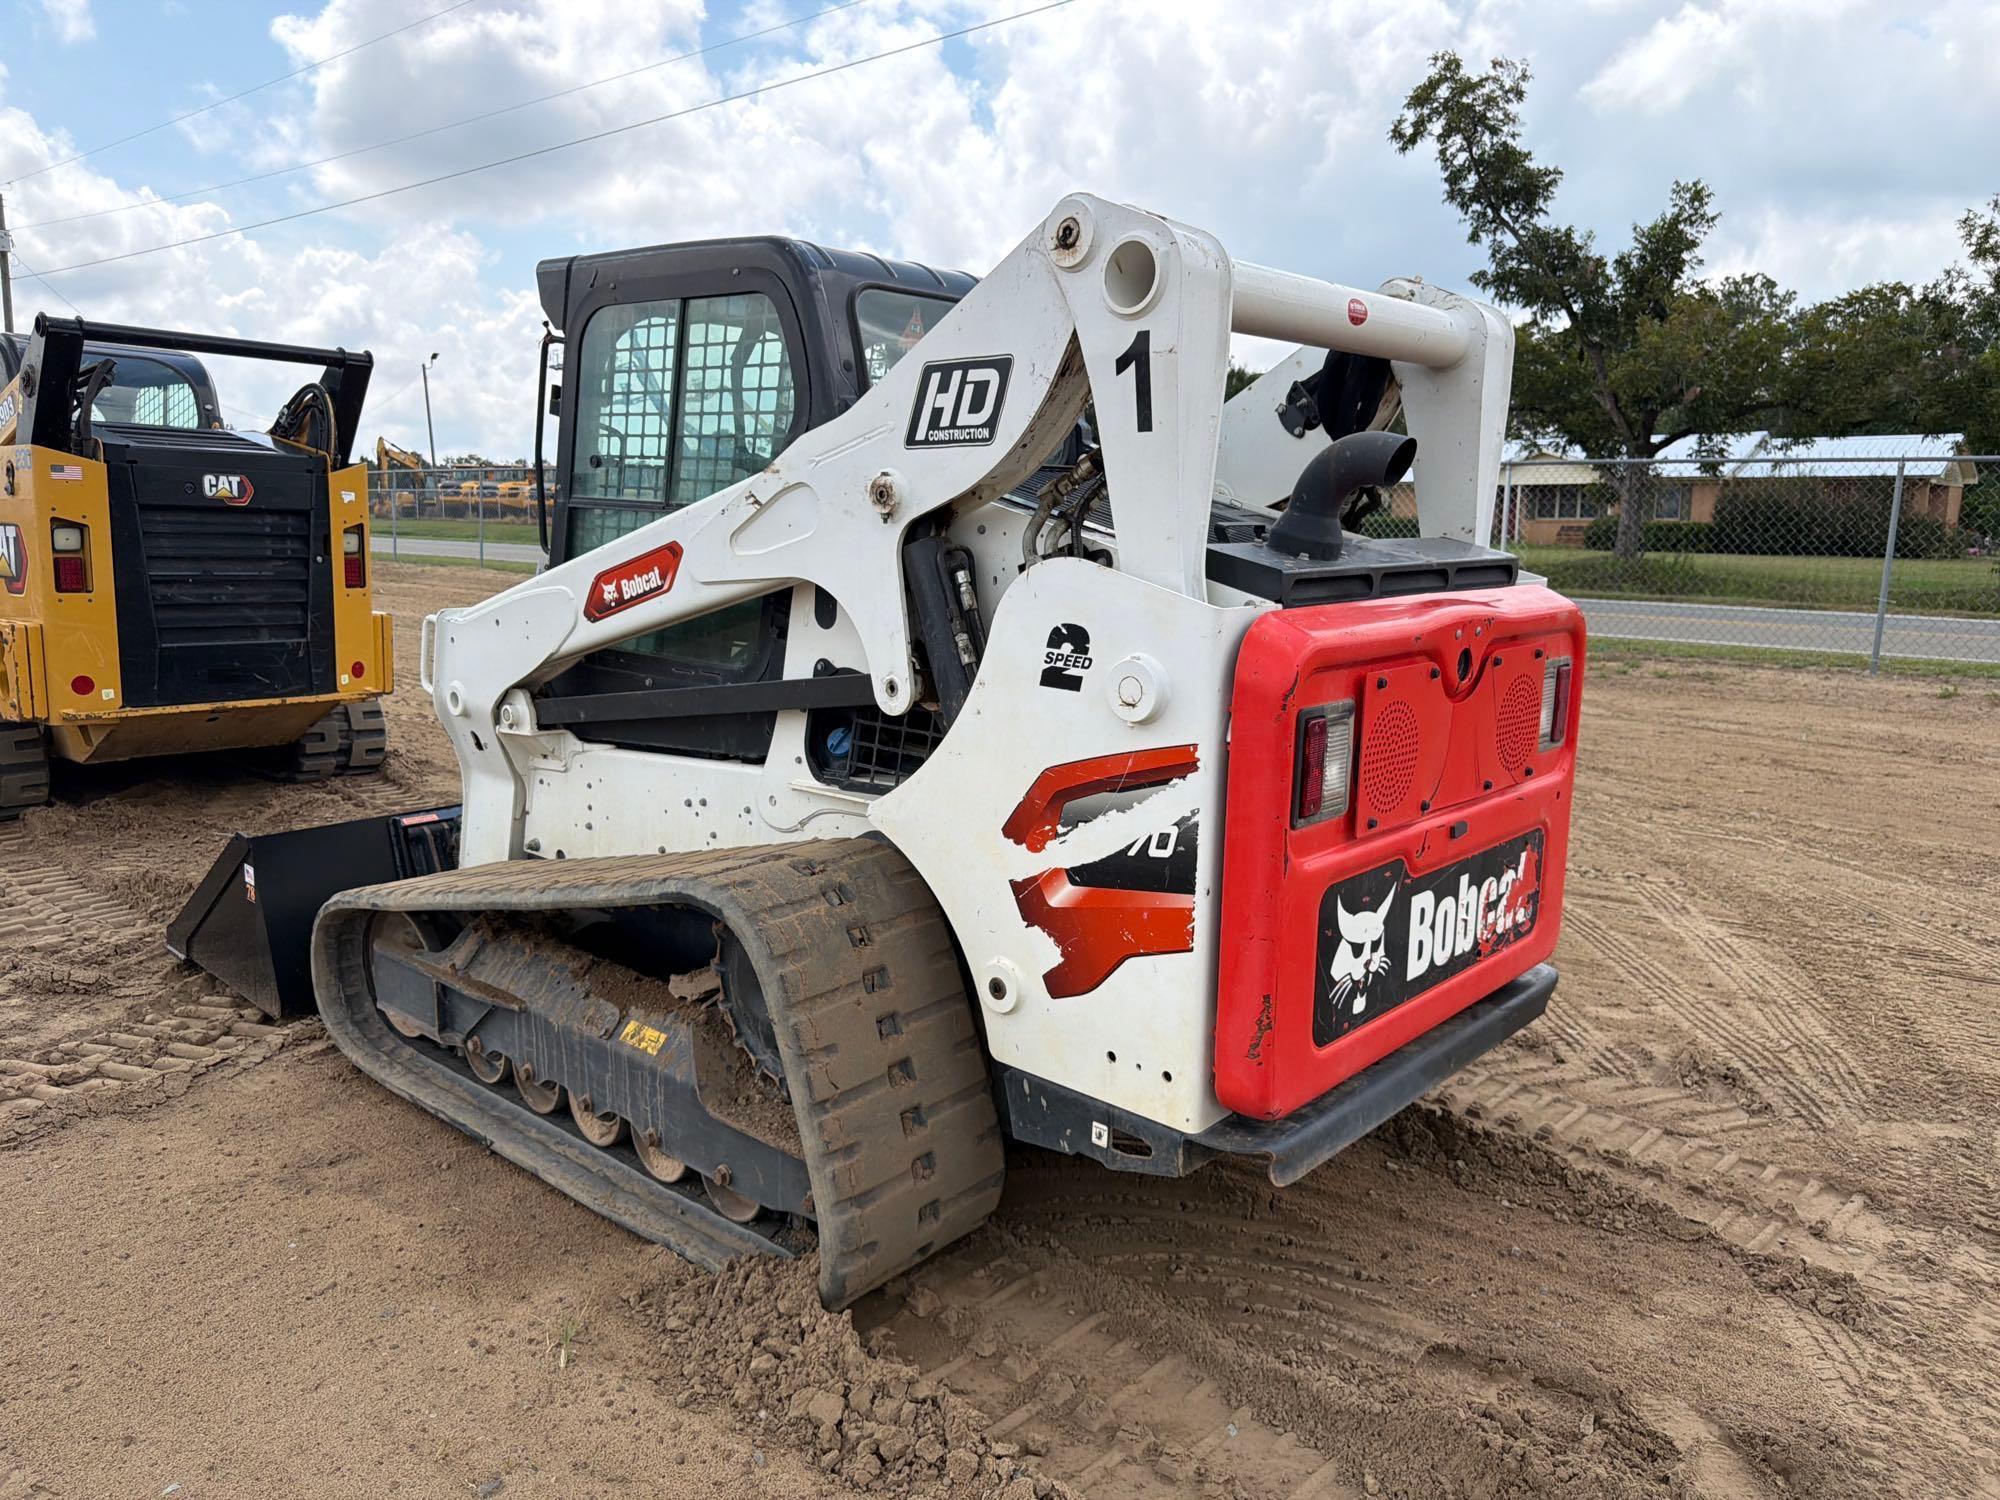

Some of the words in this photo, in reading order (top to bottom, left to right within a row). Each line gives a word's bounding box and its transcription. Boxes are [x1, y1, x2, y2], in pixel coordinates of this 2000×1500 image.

[1116, 330, 1153, 433] 1
[915, 368, 1000, 441] HD
[928, 427, 990, 441] CONSTRUCTION
[203, 474, 241, 498] CAT
[620, 566, 662, 600] Bobcat
[1044, 651, 1093, 670] SPEED
